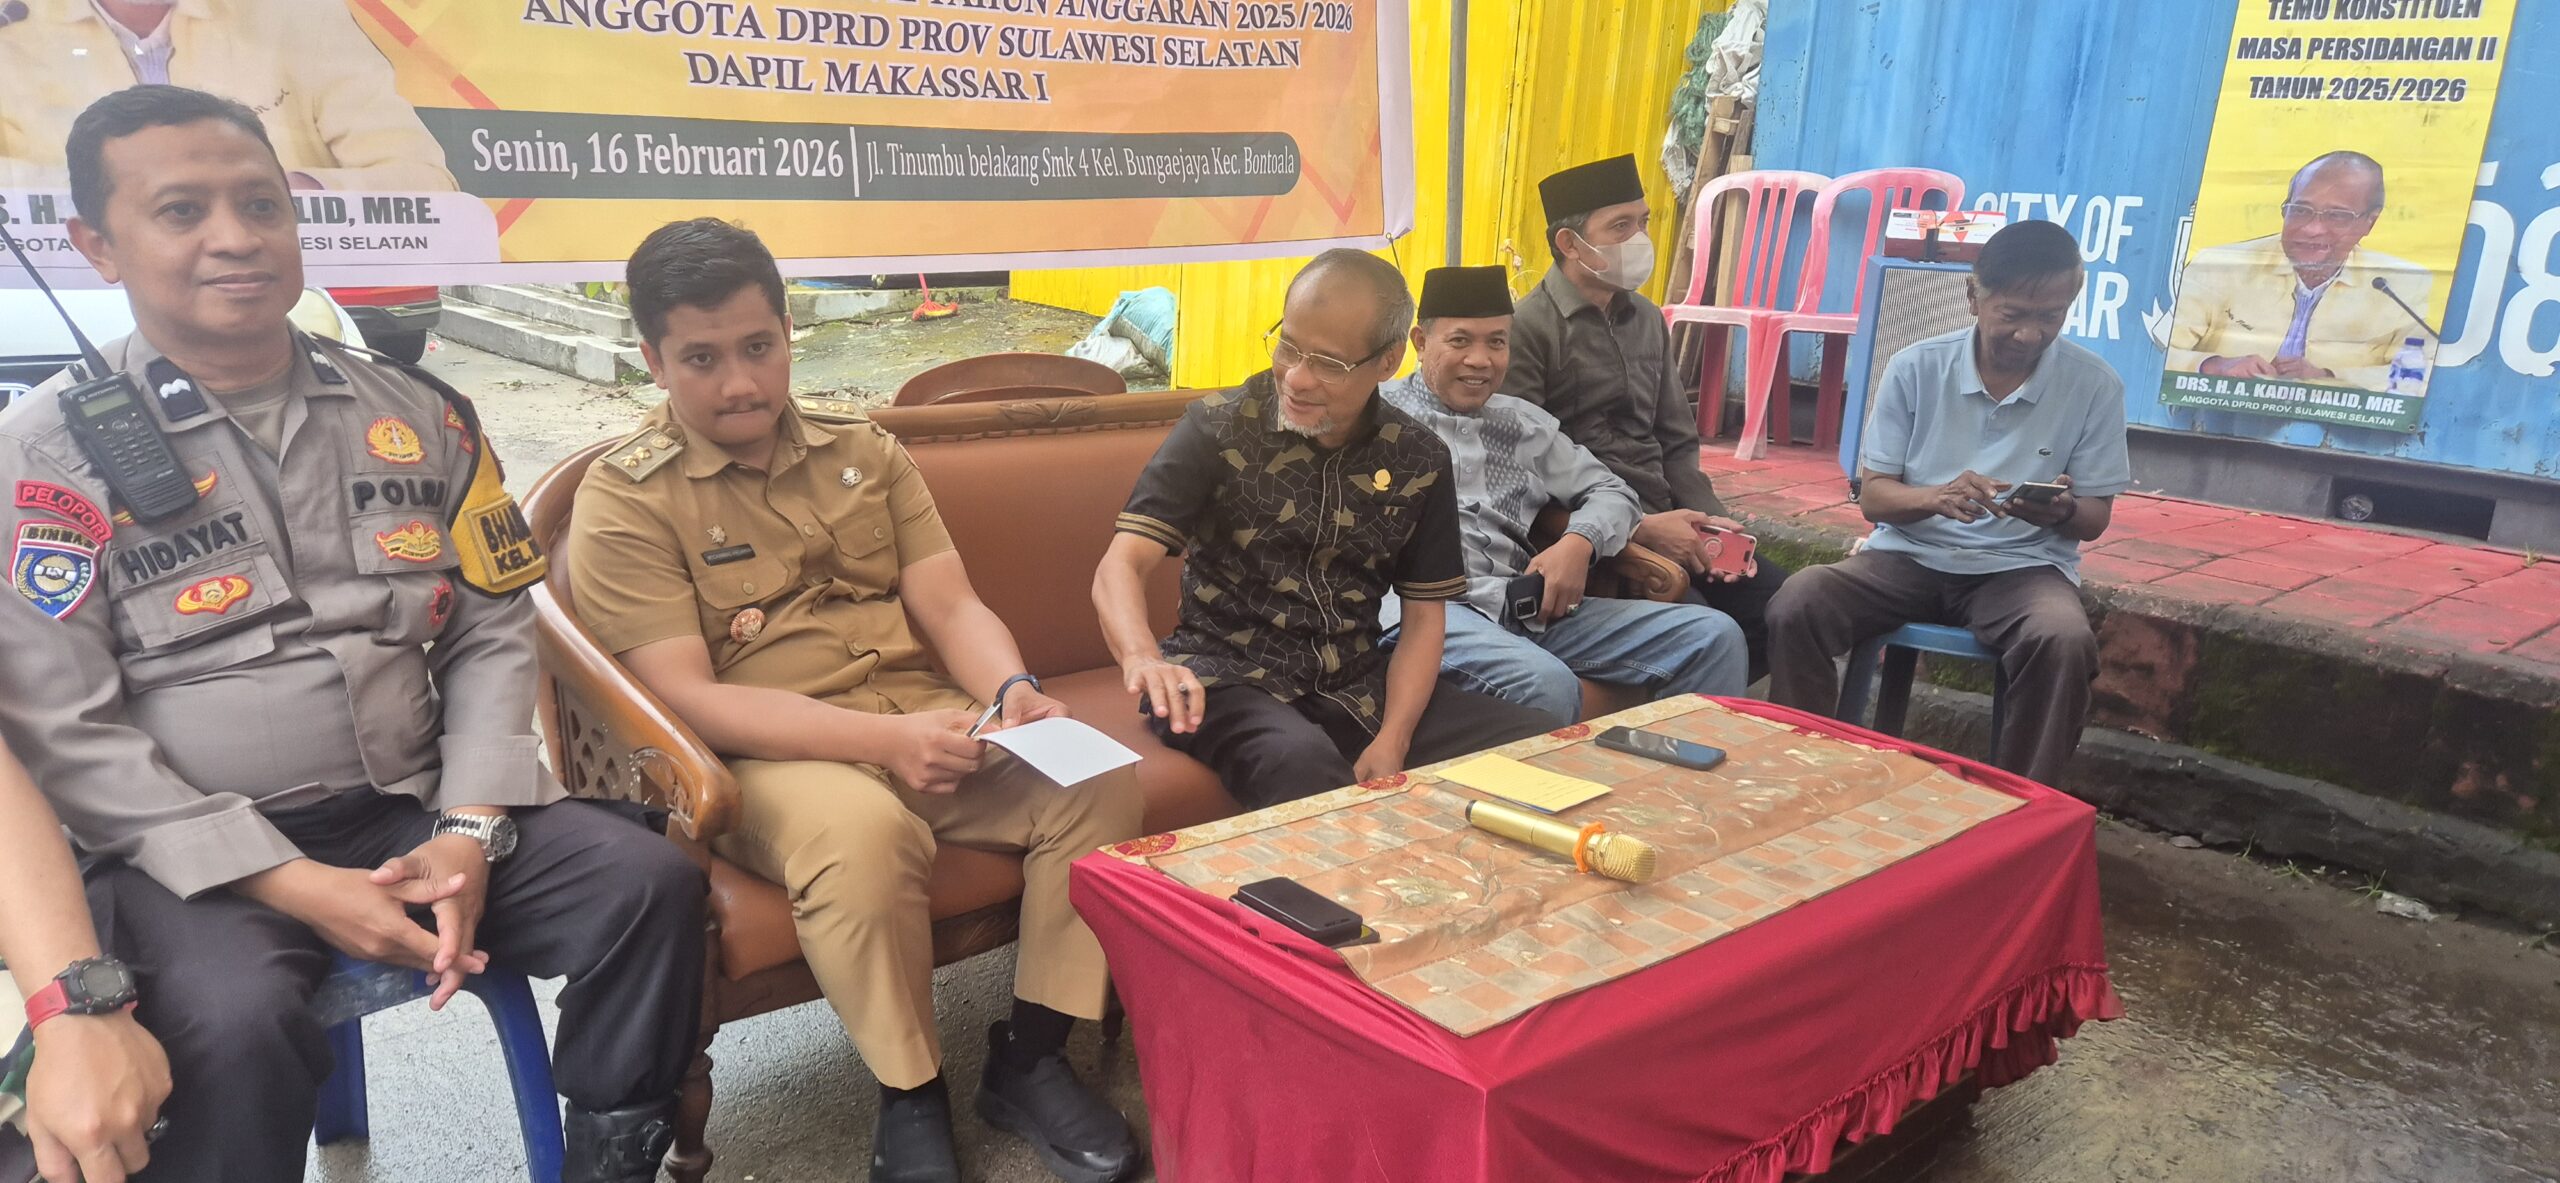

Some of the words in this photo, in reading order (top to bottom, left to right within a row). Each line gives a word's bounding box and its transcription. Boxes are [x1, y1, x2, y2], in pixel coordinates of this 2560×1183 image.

[2268, 0, 2329, 20] TEMU
[2333, 0, 2481, 20] KONSTITUEN
[523, 0, 766, 39] ANGGOTA
[776, 8, 890, 48] DPRD
[899, 18, 992, 52] PROV
[999, 26, 1157, 64] SULAWESI
[1163, 37, 1300, 67] SELATAN
[2236, 37, 2302, 60] MASA
[2306, 37, 2473, 60] PERSIDANGAN
[2476, 36, 2499, 61] II
[683, 52, 814, 91] DAPIL
[824, 61, 1030, 100] MAKASSAR
[1033, 73, 1049, 101] I
[2249, 76, 2324, 99] TAHUN
[2328, 77, 2467, 102] 2025/2026
[471, 128, 578, 179] Senin,
[587, 132, 628, 174] 16
[635, 133, 768, 176] Februari
[774, 137, 844, 177] 2026
[866, 141, 884, 183] Jl.
[887, 143, 965, 177] Tinumbu
[967, 144, 1039, 186] belakang
[1042, 146, 1077, 177] Smk
[1079, 147, 1089, 176] 4
[1091, 147, 1123, 176] Kel.
[1124, 148, 1210, 184] Bungaejaya
[1211, 147, 1240, 175] Kec.
[1244, 145, 1295, 175] Bontoala
[292, 196, 356, 227] LID,
[362, 197, 441, 224] MRE.
[2079, 195, 2144, 265] OF
[340, 236, 428, 250] SELATAN
[2175, 376, 2212, 393] DRS.
[2215, 379, 2232, 395] H.
[2234, 381, 2250, 397] A.
[2253, 383, 2307, 402] KADIR
[2309, 388, 2362, 410] HALID,
[2365, 395, 2406, 415] MRE.
[2181, 394, 2230, 407] ANGGOTA
[2232, 400, 2260, 411] DPRD
[2262, 403, 2292, 414] PROV.
[2295, 407, 2347, 420] SULAWESI
[2349, 412, 2395, 427] SELATAN
[21, 485, 106, 540] PELOPOR
[353, 478, 446, 511] POLRI
[118, 511, 248, 585] HIDAYAT
